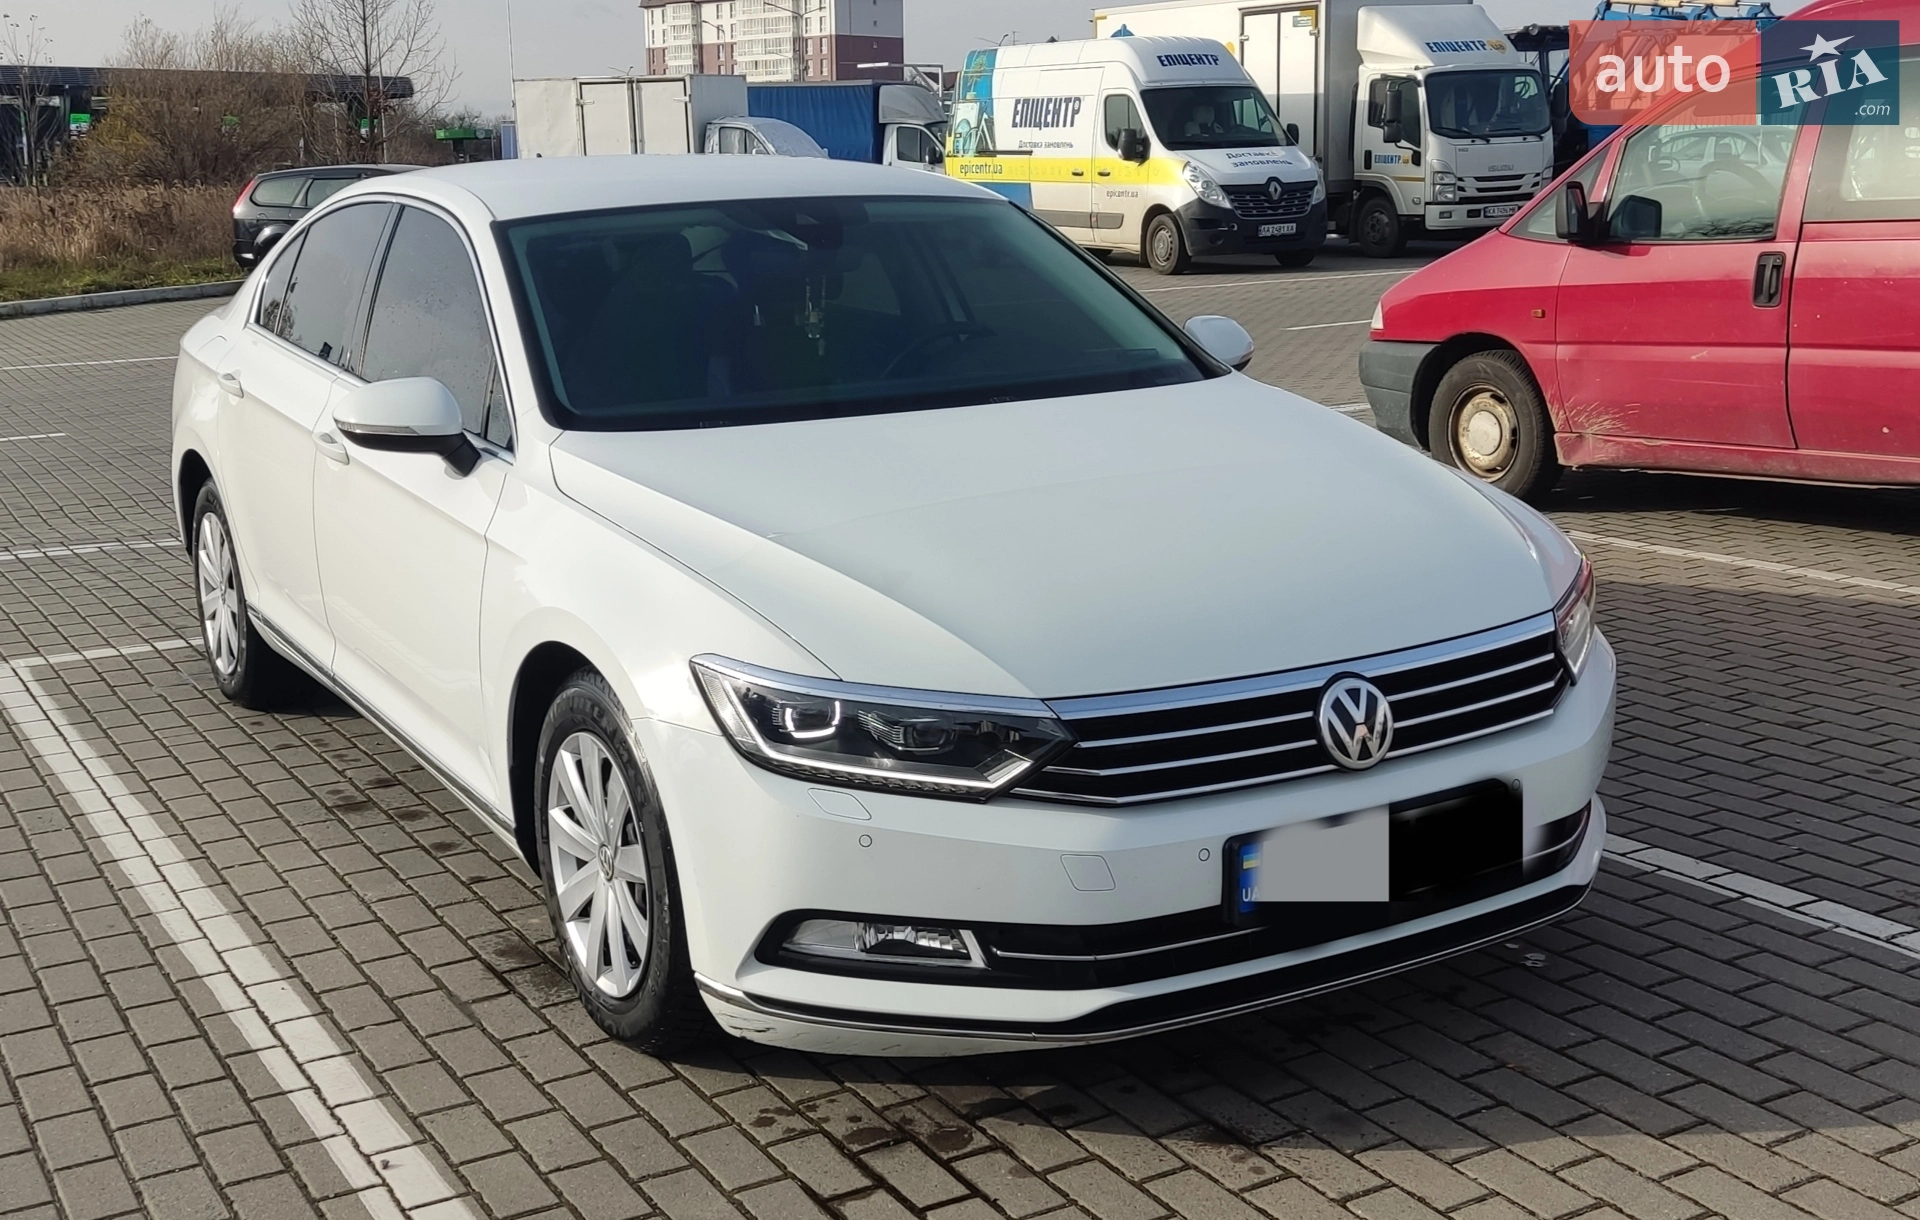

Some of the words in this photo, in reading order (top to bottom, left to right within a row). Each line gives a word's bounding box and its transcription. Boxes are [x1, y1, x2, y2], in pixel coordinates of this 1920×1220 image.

[1156, 53, 1219, 67] ЕПІЦЕНТР
[1011, 96, 1082, 130] ЕПІЦЕНТР
[959, 160, 1003, 176] epicentr.ua
[1106, 189, 1139, 198] epicentr.ua
